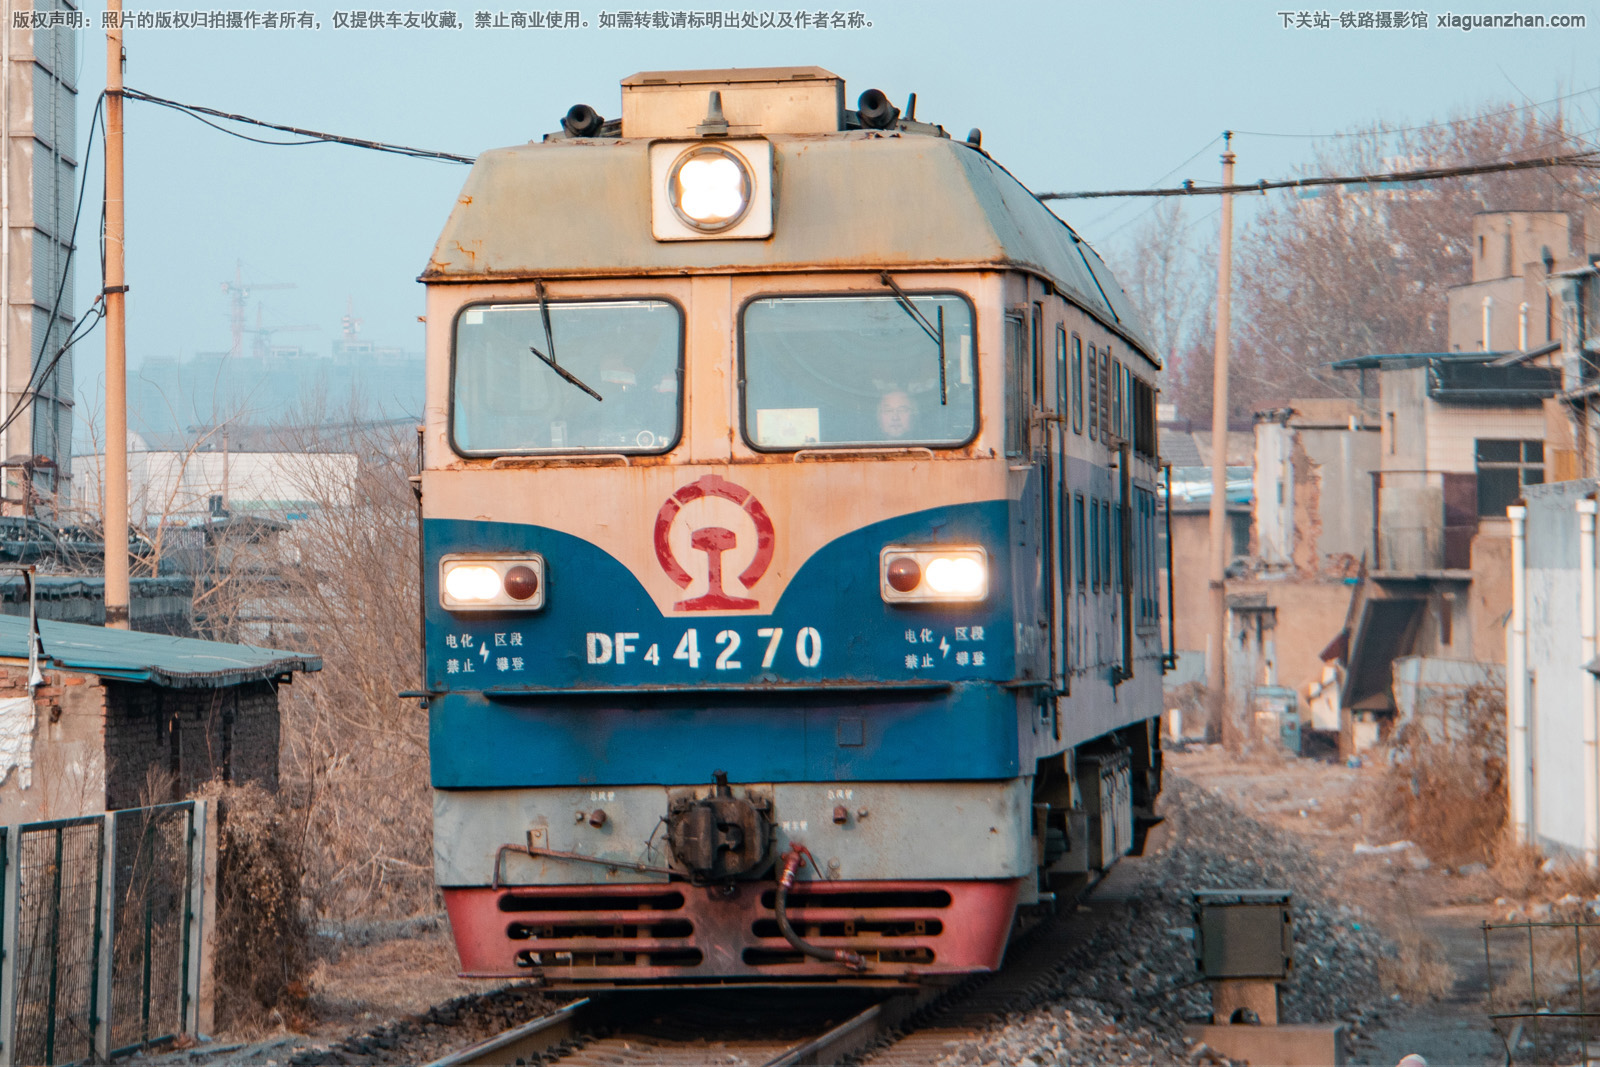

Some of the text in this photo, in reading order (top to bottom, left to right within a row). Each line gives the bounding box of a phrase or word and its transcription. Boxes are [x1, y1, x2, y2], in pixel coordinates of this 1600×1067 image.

[446, 632, 523, 649] 电化 区段
[905, 625, 985, 643] 电化 区段
[446, 658, 475, 674] 禁止
[904, 653, 935, 669] 禁止
